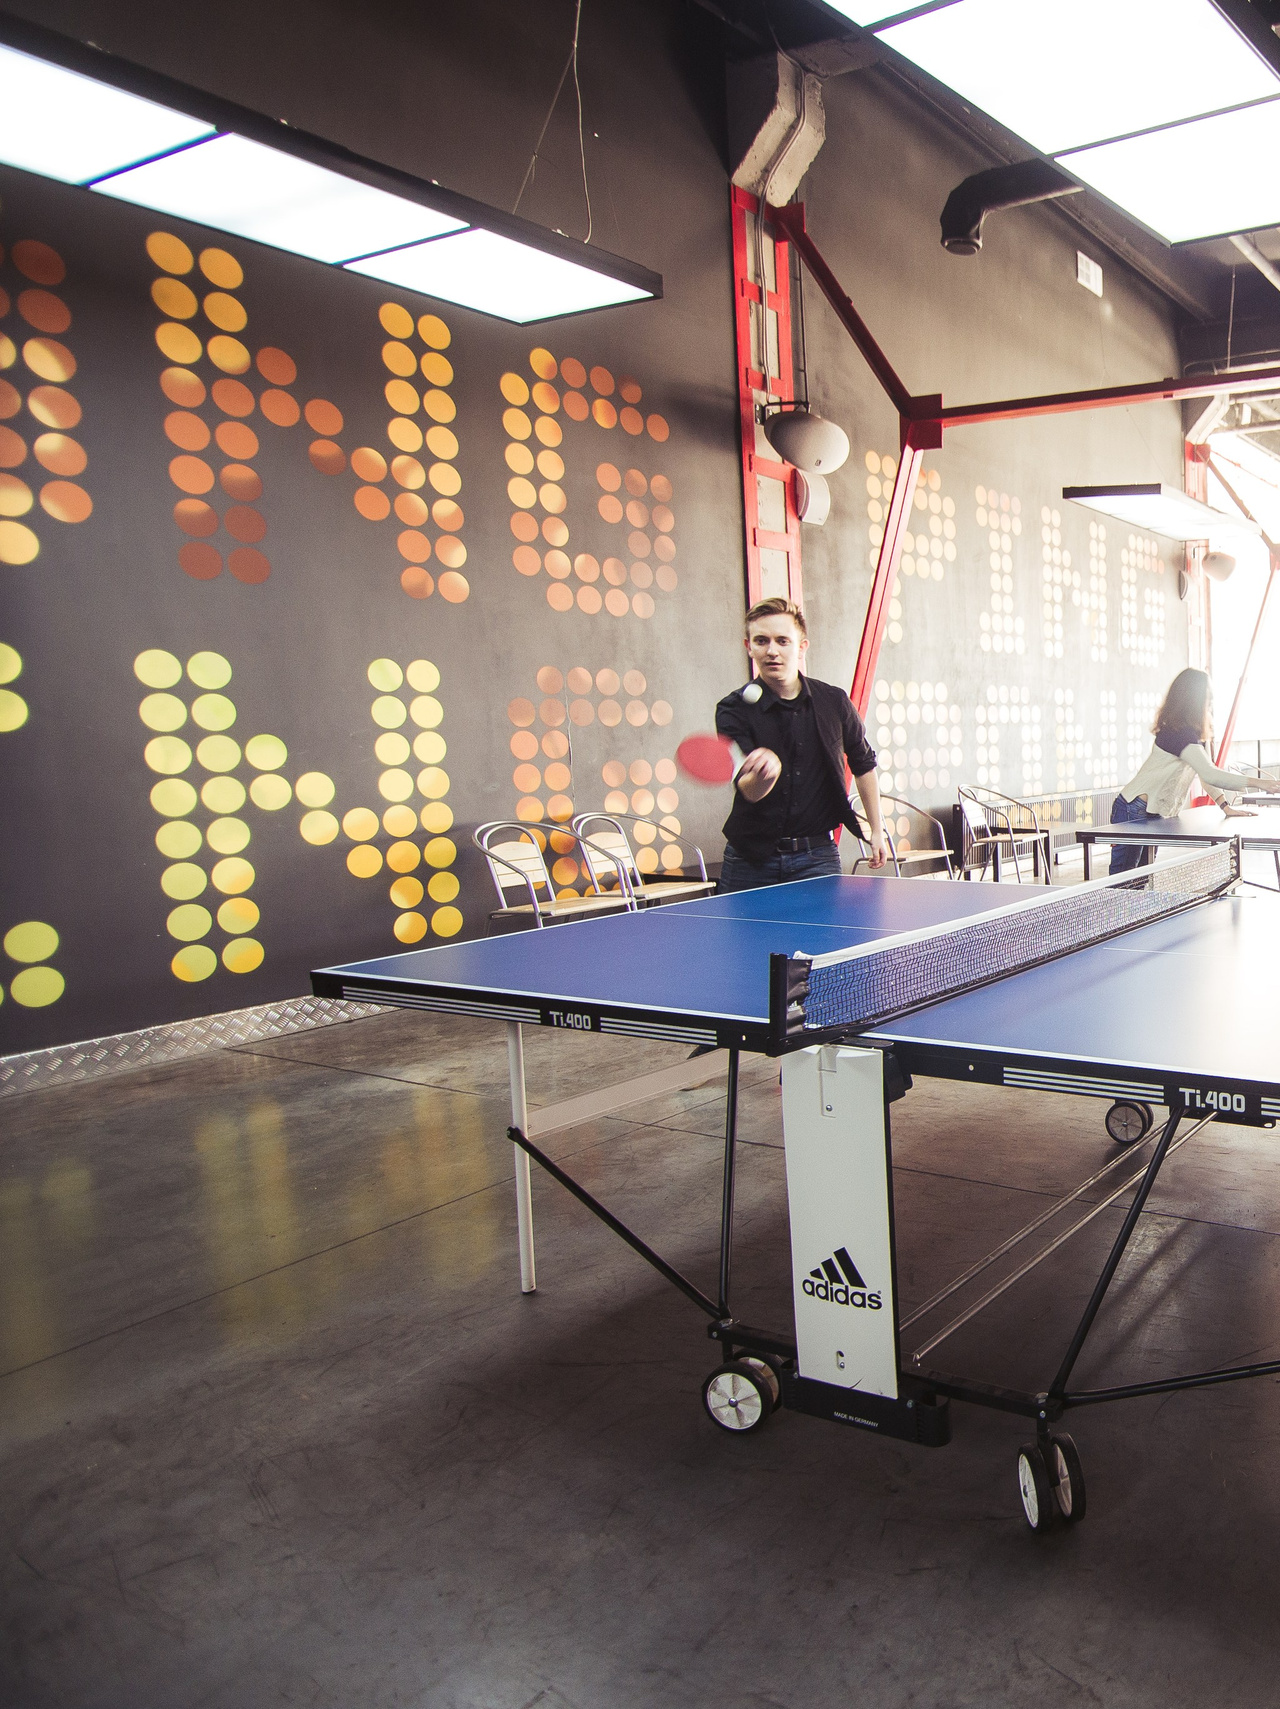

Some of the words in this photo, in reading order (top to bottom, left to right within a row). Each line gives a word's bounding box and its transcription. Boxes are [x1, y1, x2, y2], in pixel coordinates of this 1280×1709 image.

[865, 450, 1165, 667] PING
[549, 1010, 592, 1030] Ti.400
[1178, 1087, 1246, 1113] Ti.400
[802, 1278, 883, 1310] adidas
[833, 1411, 848, 1419] MADE
[854, 1416, 879, 1427] GERMANY
